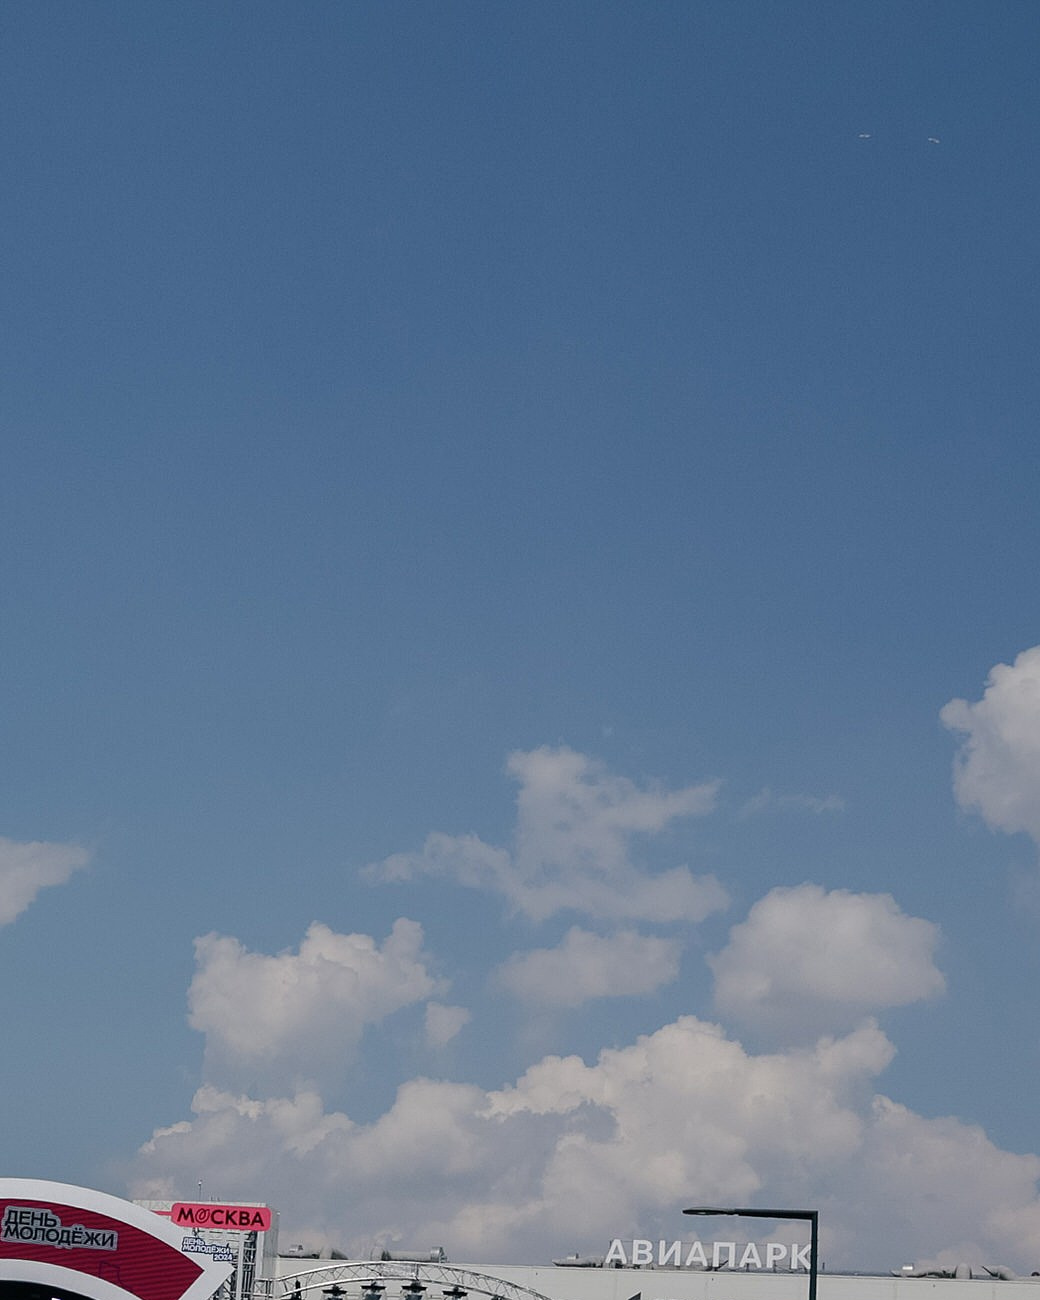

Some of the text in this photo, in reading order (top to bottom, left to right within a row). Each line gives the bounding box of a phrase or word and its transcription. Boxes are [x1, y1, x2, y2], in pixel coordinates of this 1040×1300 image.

[4, 1210, 57, 1228] ДЕНЬ
[176, 1207, 265, 1227] МОСКВА
[3, 1224, 115, 1248] МОЛОДЁЖИ
[183, 1237, 205, 1246] ДЕНЬ
[605, 1238, 813, 1270] АВИАПАРК
